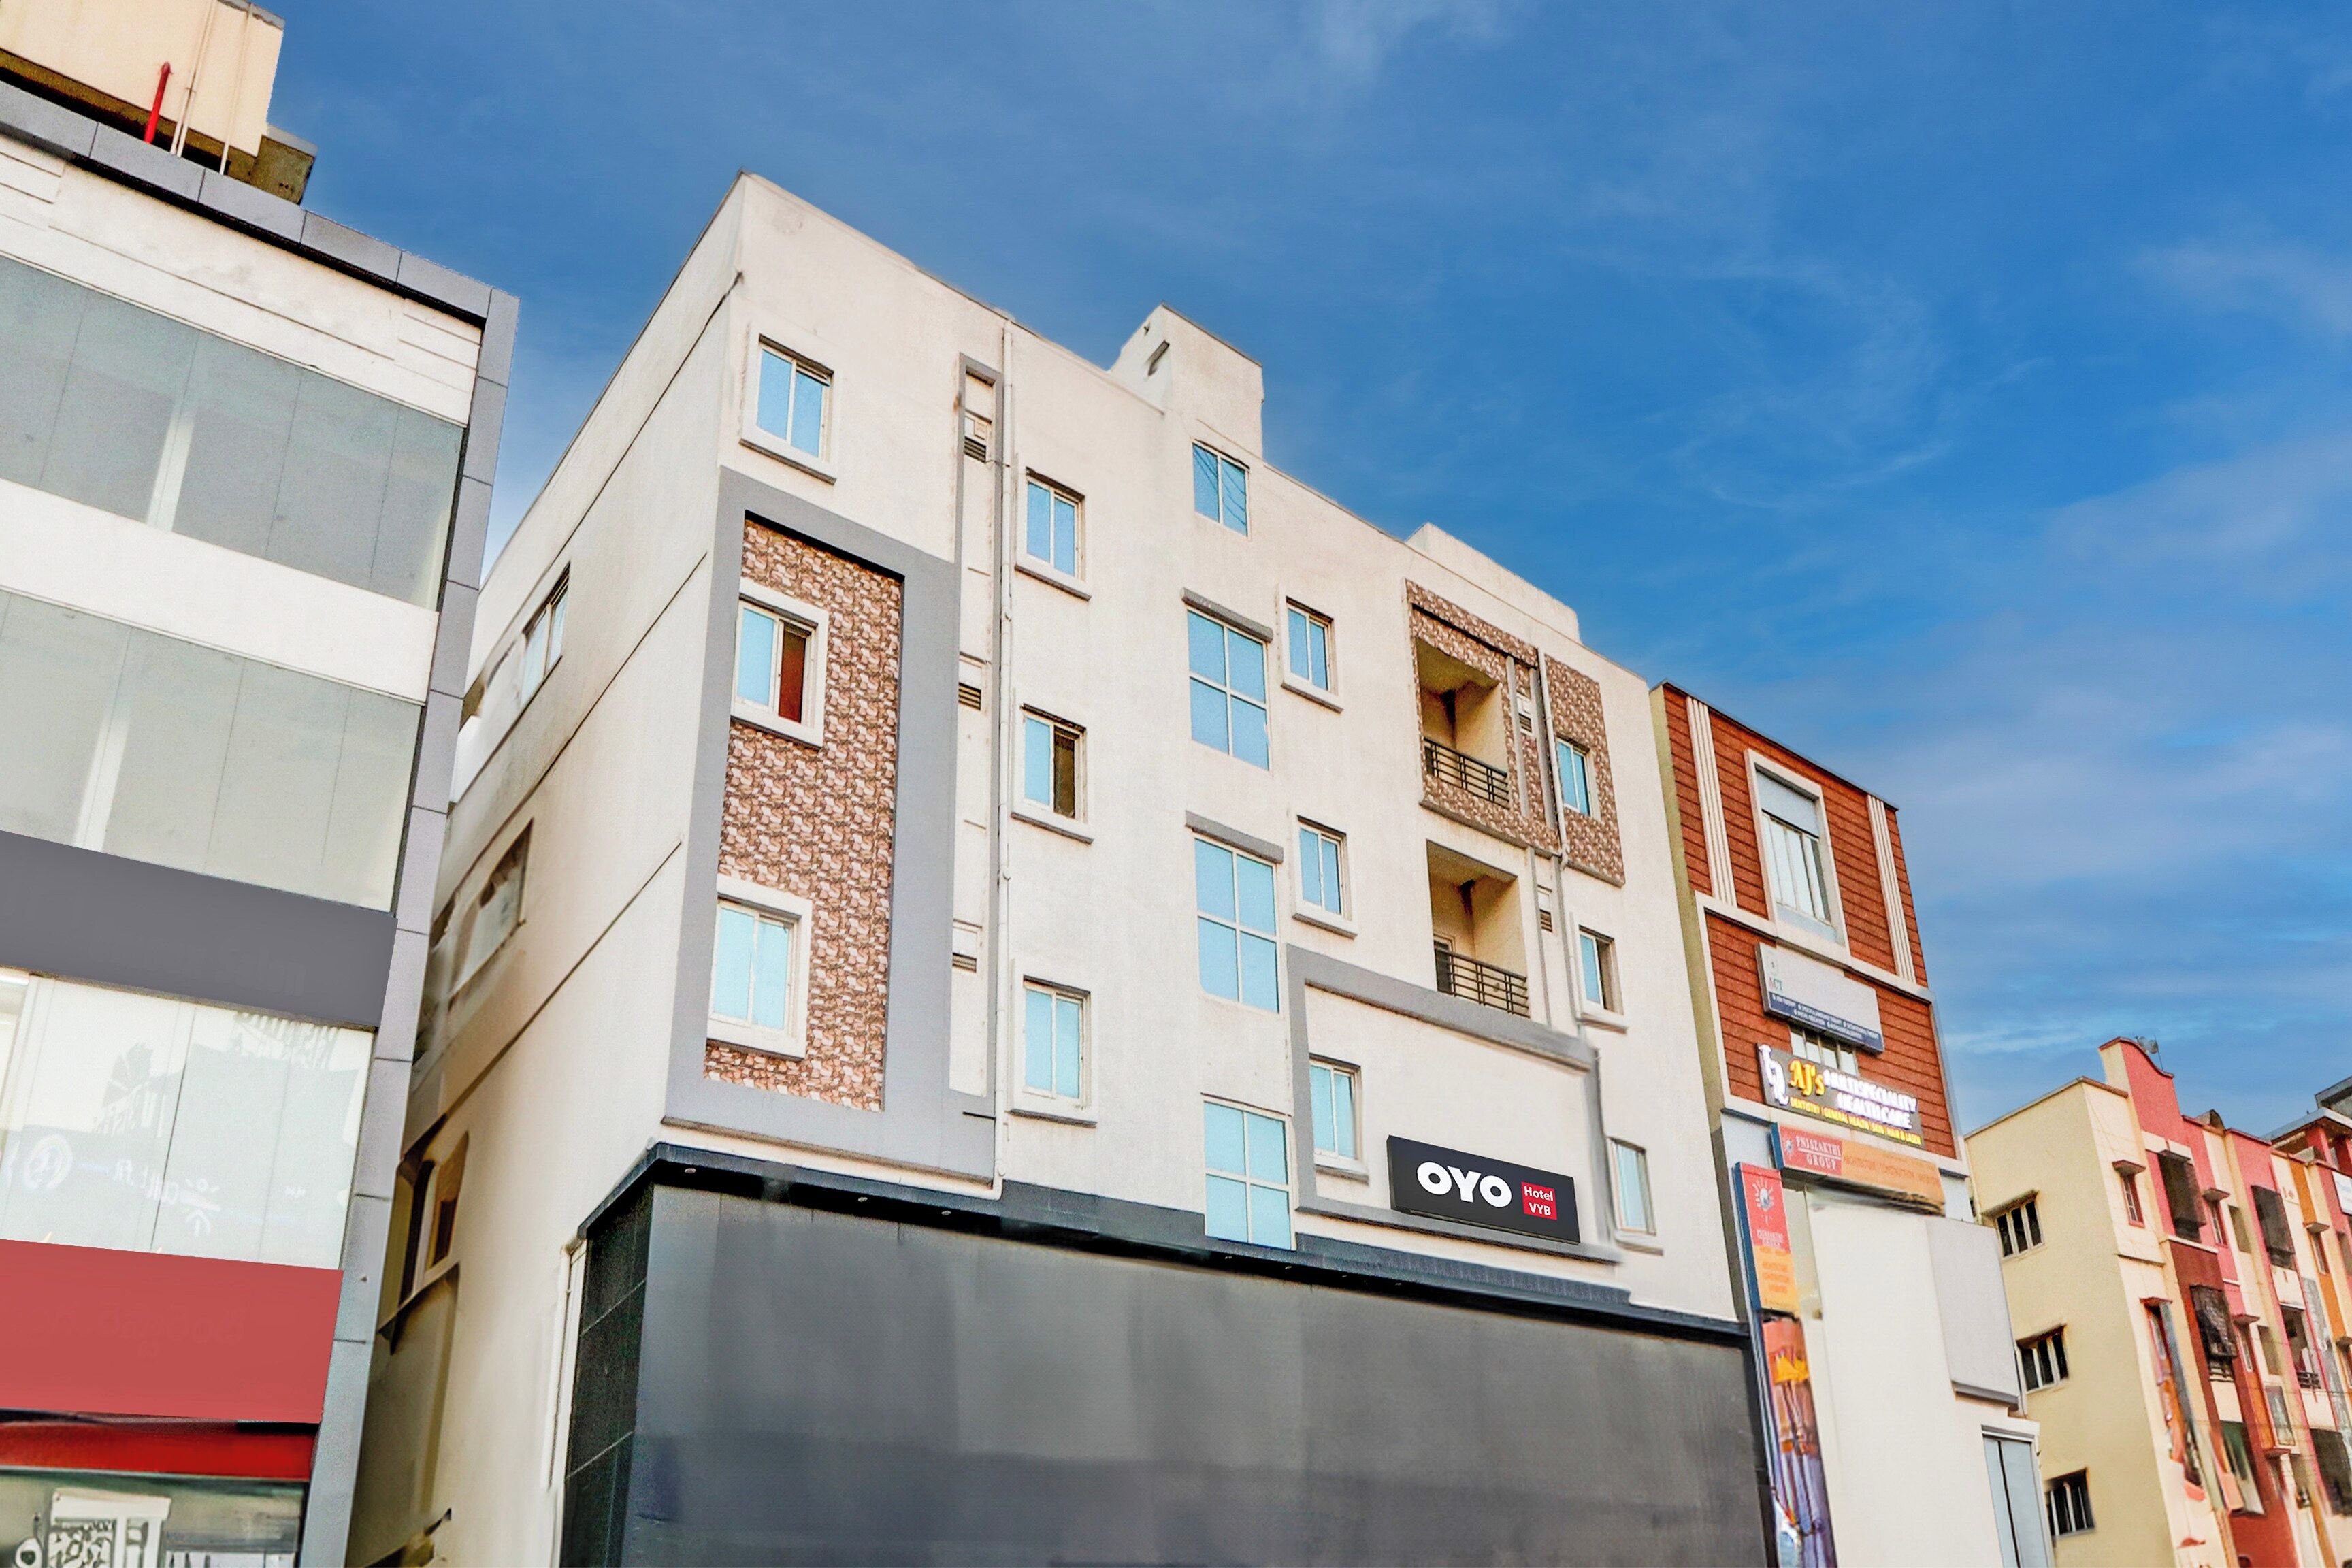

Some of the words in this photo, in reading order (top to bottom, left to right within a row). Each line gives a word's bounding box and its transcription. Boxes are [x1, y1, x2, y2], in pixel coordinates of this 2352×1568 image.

[1788, 1059, 1825, 1096] AJ's
[1806, 1154, 1837, 1170] GROUP
[1416, 1161, 1512, 1208] OYO
[1524, 1186, 1554, 1201] Hotel
[1529, 1202, 1551, 1216] VYB
